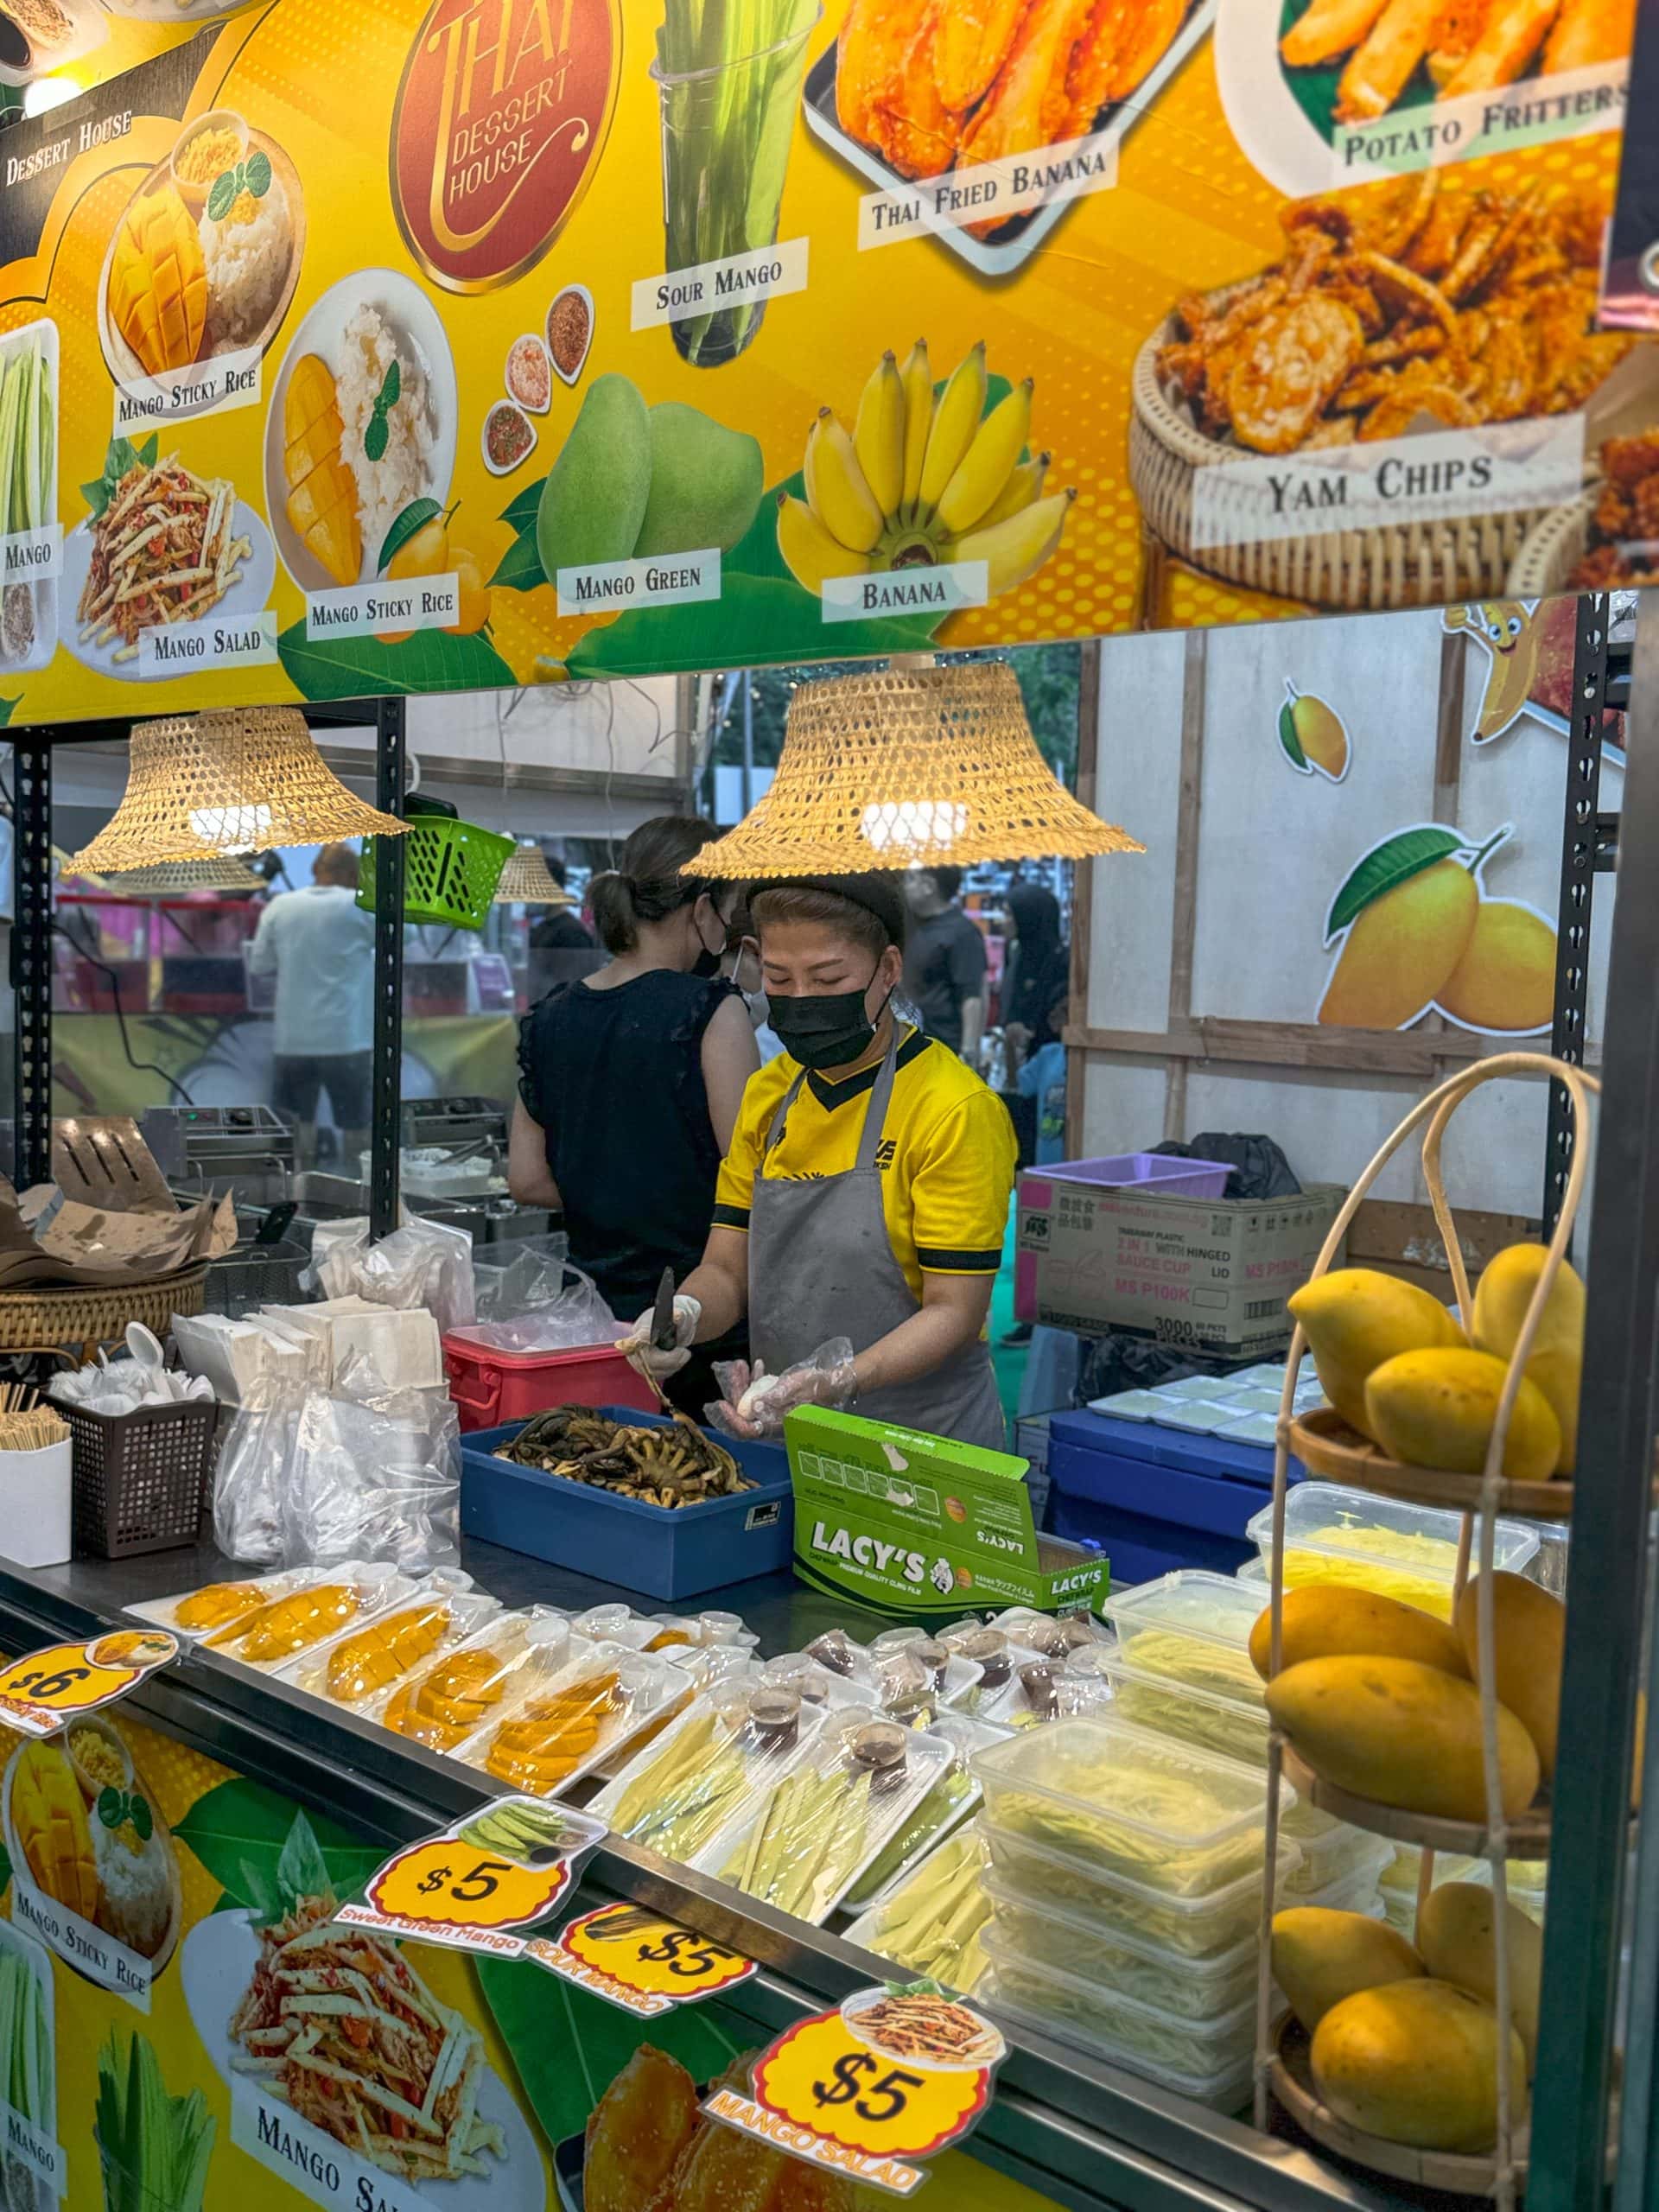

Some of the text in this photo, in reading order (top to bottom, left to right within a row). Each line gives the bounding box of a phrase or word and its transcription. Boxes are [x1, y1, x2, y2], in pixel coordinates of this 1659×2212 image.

[452, 58, 573, 167] DESSERT
[6, 110, 131, 187] DESSERT HOUSE
[449, 129, 533, 207] HOUSE
[1344, 120, 1461, 167] POTATO
[872, 150, 1106, 231] THAI FRIED BANANA
[657, 261, 782, 311] SOUR MANGO
[119, 367, 256, 423] MANGO STICKY RICE
[1268, 456, 1492, 514] YAM CHIPS
[5, 543, 51, 572] MANGO
[575, 566, 701, 601] MANGO GREEN
[863, 581, 946, 610] BANANA
[312, 593, 453, 626] MANGO STICKY RICE
[155, 629, 261, 660] MANGO SALAD
[1116, 1253, 1192, 1274] SAUCE CUP
[1155, 1242, 1185, 1258] WITH
[1186, 1246, 1231, 1262] HINGED
[1211, 1267, 1230, 1280] LID
[1154, 1316, 1193, 1337] 3000
[810, 1520, 926, 1583] LACY'S
[976, 1529, 1025, 1555] LACY'S
[1051, 1569, 1103, 1595] LACY'S
[16, 1891, 147, 1996] MANGO STICKY RICE
[340, 1907, 520, 1951] Sweet Green Mango
[527, 1938, 664, 2012] SOUR MANGO
[638, 1930, 735, 1978] $5
[811, 2051, 926, 2122] $5
[8, 2114, 55, 2172] MANGO
[257, 2106, 340, 2192] MANGO
[709, 2093, 918, 2190] MANGO SALAD
